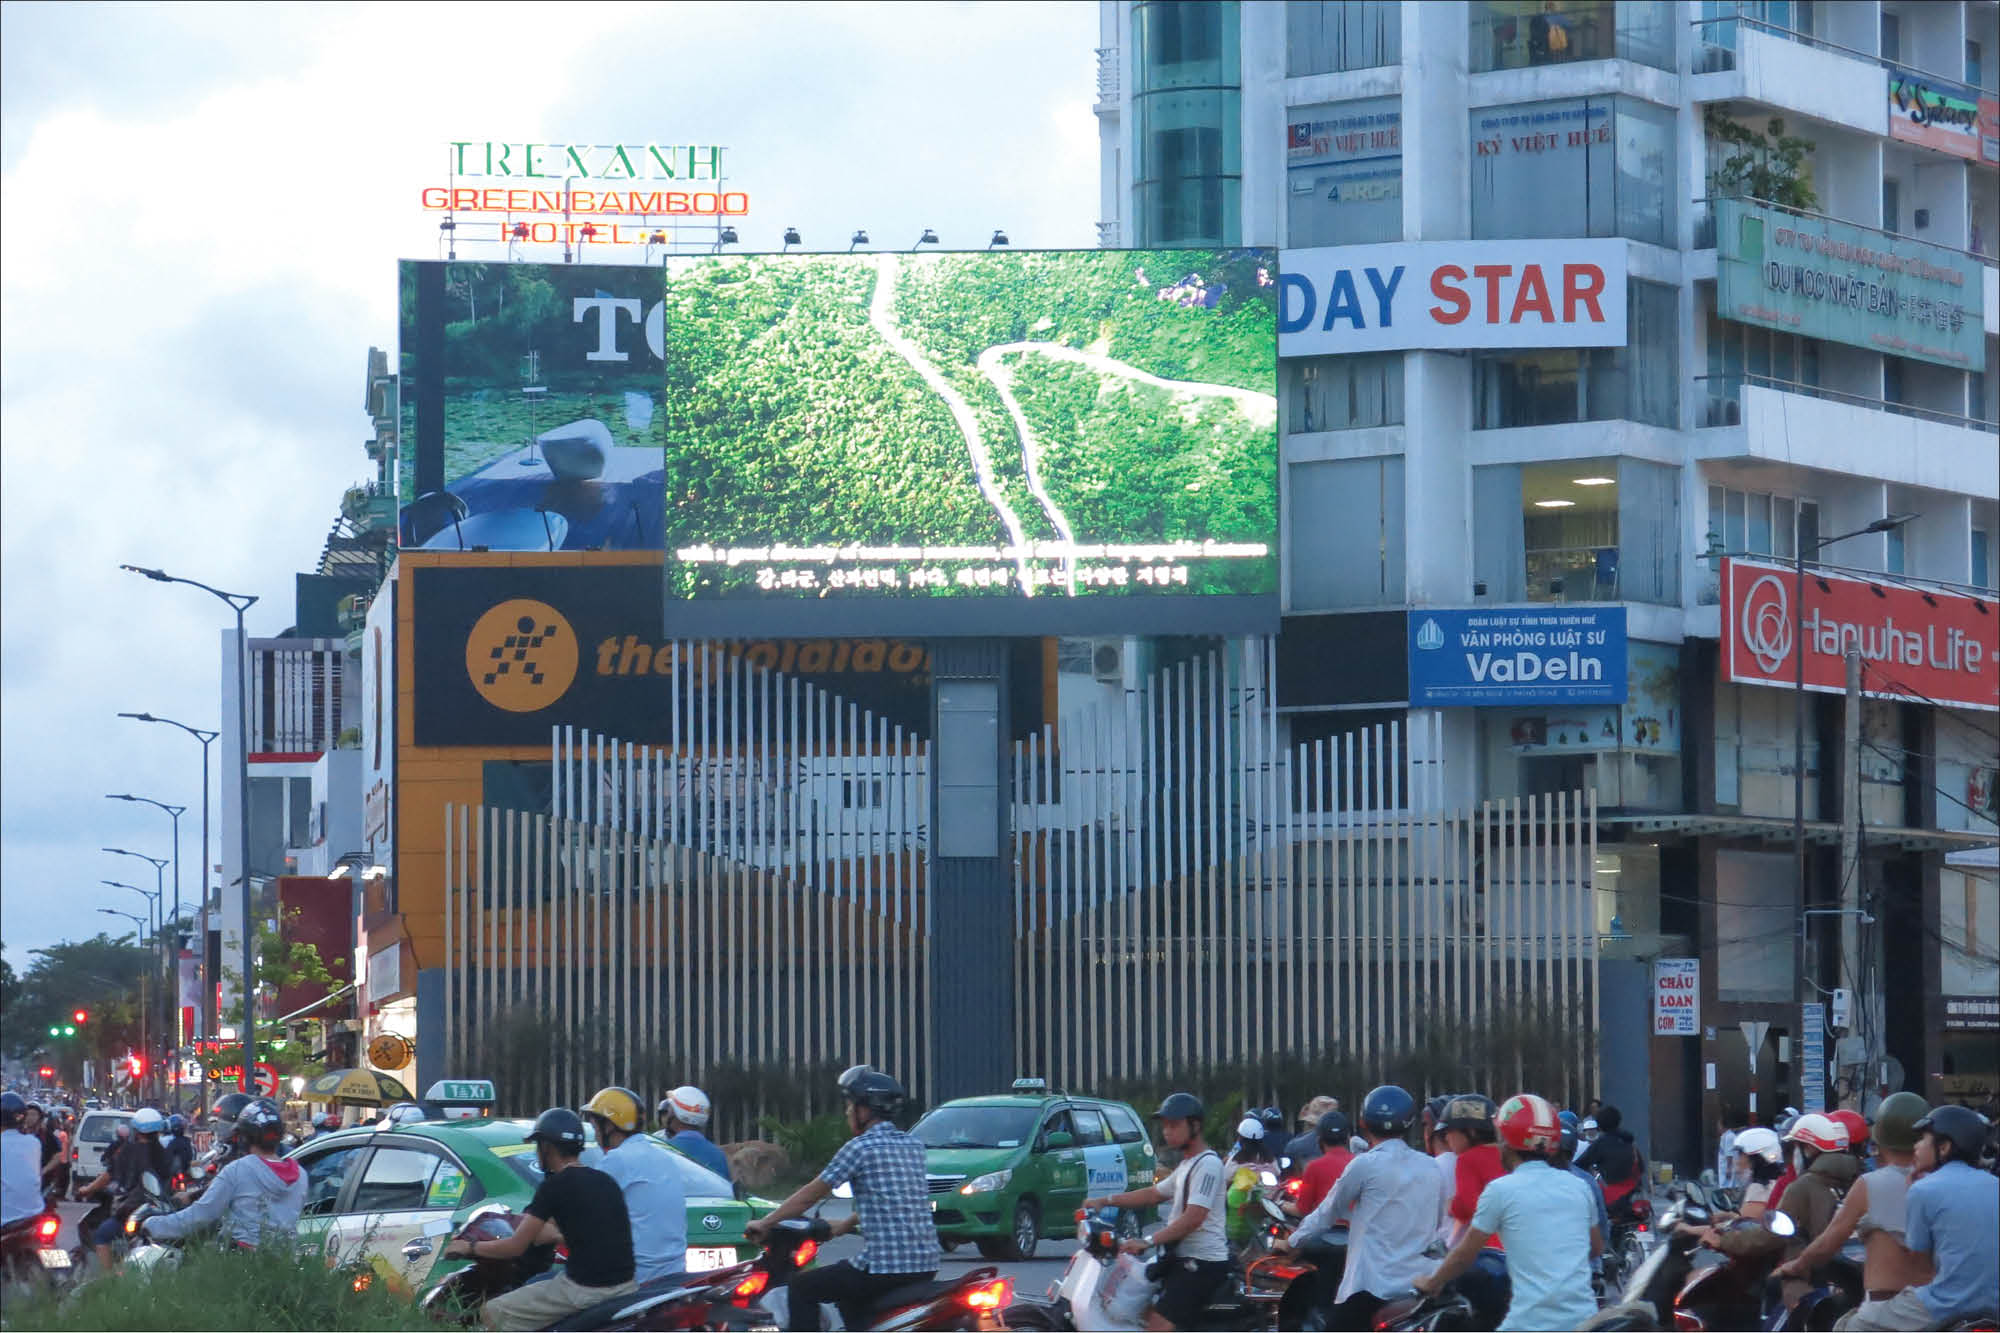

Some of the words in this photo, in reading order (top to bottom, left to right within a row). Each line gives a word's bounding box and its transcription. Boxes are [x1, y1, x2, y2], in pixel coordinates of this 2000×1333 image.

[421, 186, 562, 212] GREEN
[569, 190, 749, 215] BAMBOO
[501, 222, 631, 245] HOTEL
[1770, 261, 1791, 292] DU
[1279, 265, 1406, 334] DAY
[1428, 262, 1606, 326] STAR
[573, 297, 665, 361] T
[1493, 629, 1546, 647] PHÒNG
[1550, 629, 1583, 649] LUẬT
[1587, 630, 1607, 645] SƯ
[1928, 623, 1982, 673] Life
[1659, 974, 1694, 990] CHÂU
[1660, 994, 1694, 1008] LOAN
